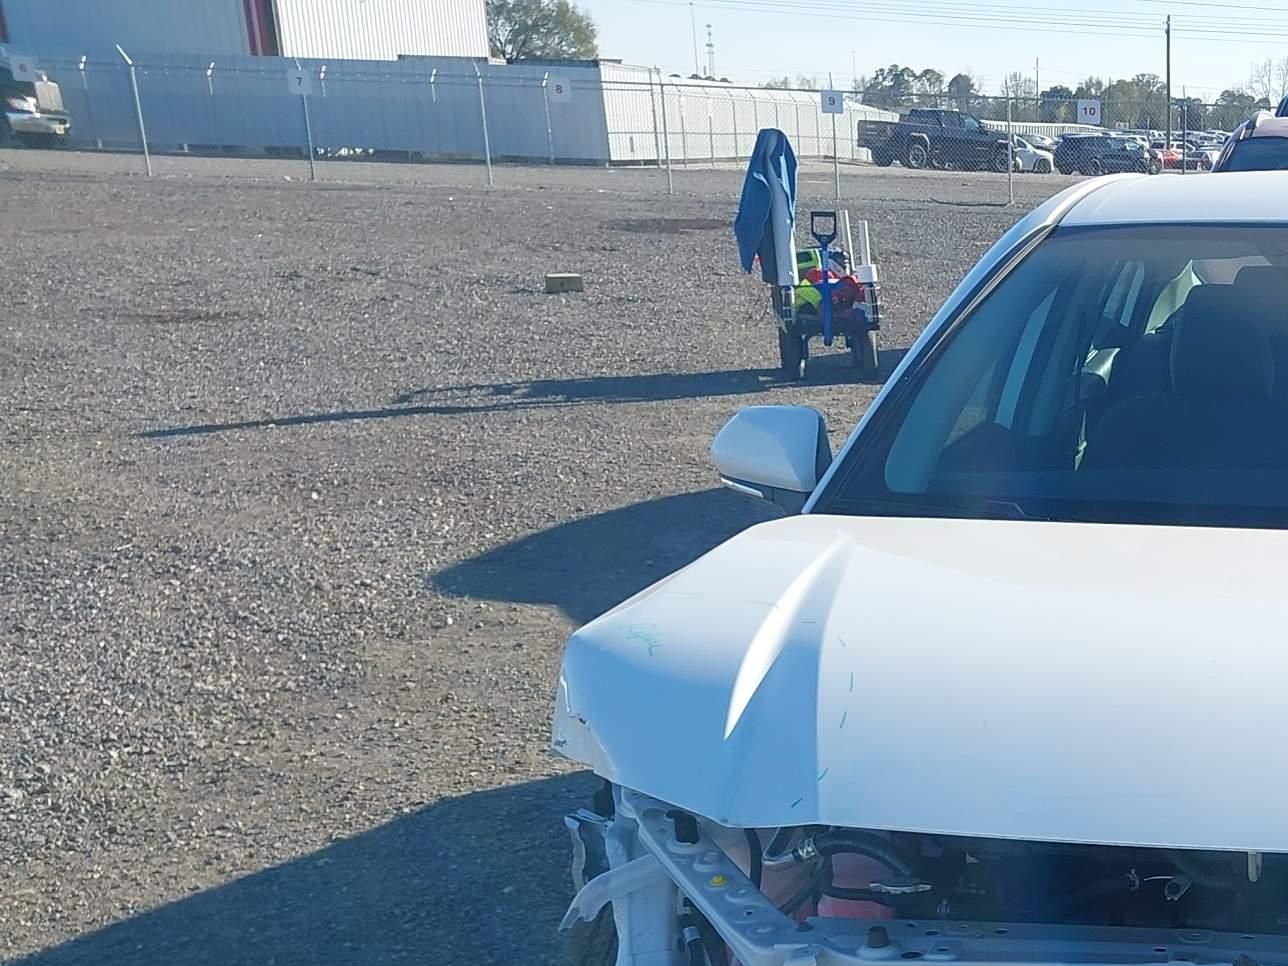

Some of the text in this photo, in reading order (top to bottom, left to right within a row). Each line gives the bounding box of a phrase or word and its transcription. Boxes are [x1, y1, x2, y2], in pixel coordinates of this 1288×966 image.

[295, 76, 303, 86] 7
[828, 96, 836, 106] 9
[1082, 106, 1096, 116] 10
